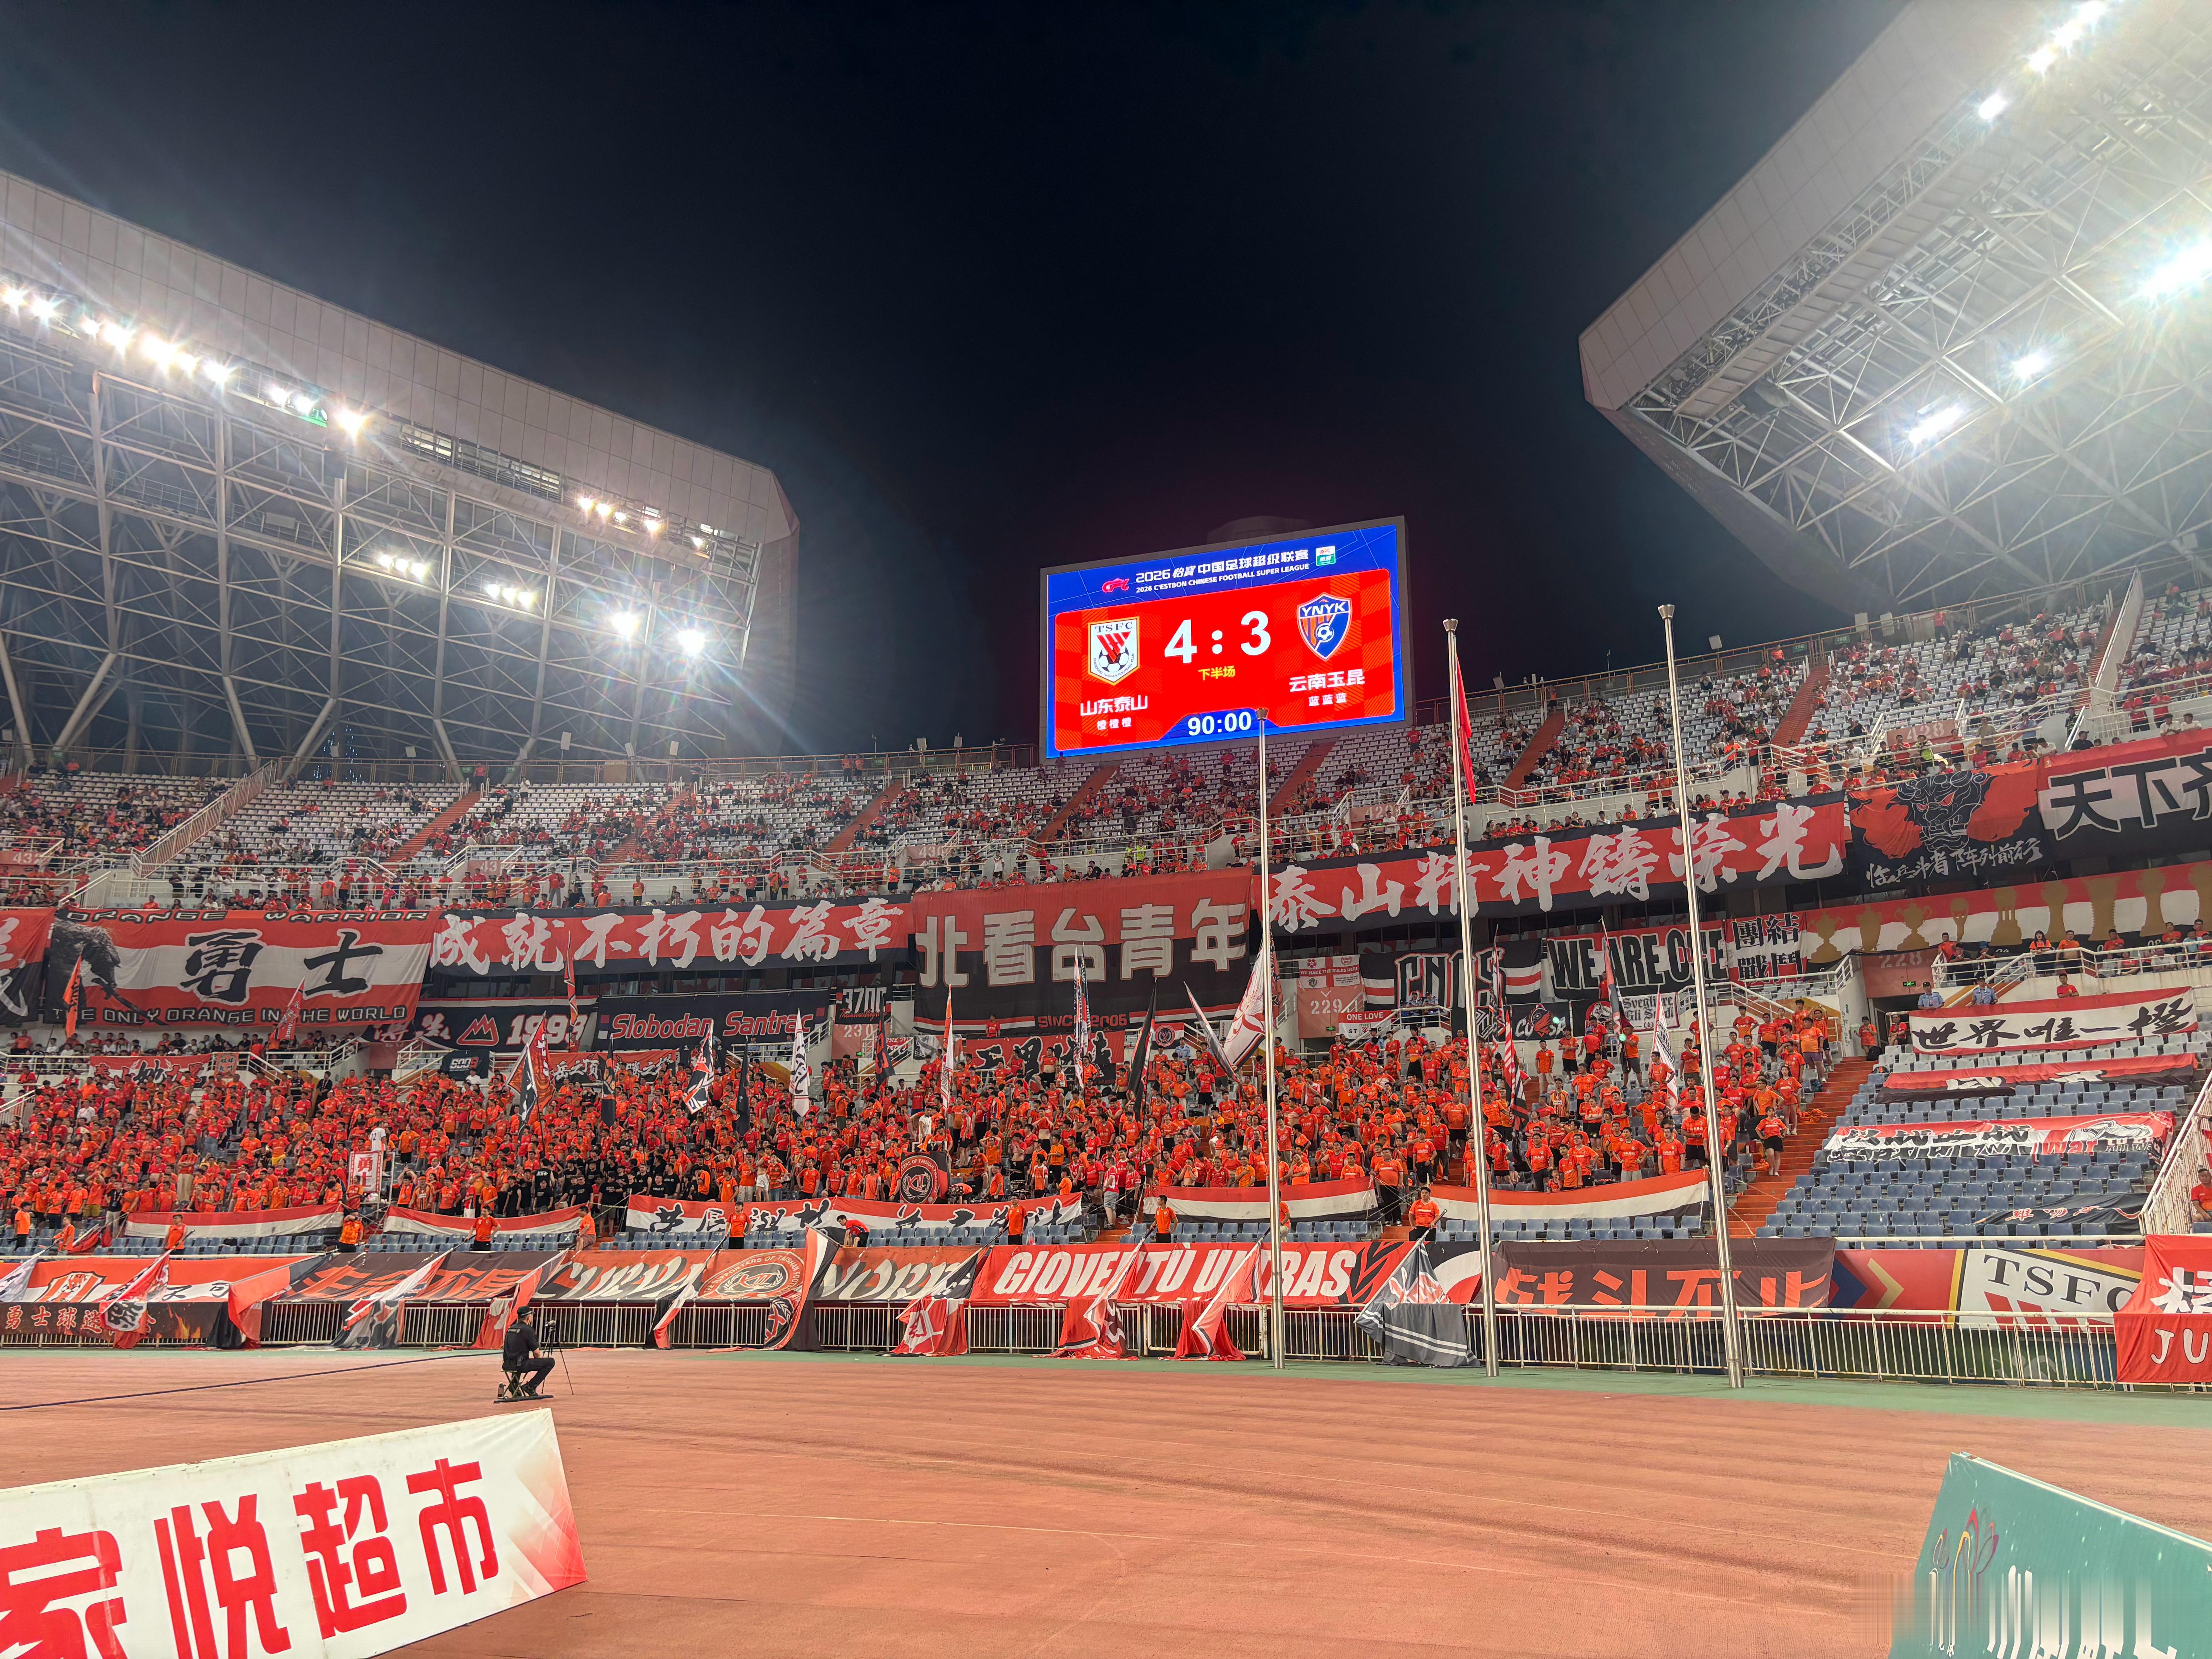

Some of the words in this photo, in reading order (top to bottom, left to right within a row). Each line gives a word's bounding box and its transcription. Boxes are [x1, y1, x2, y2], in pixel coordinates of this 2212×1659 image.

[1136, 569, 1171, 583] 2026
[1198, 549, 1309, 574] 中国足球超级联赛
[1136, 585, 1152, 593] 2026
[1153, 581, 1187, 591] C'ESTBON
[1188, 577, 1218, 586] CHINESE
[1218, 572, 1255, 582] FOOTBALL
[1256, 568, 1279, 577] SUPER
[1280, 563, 1309, 573] LEAGUE
[1302, 601, 1346, 617] YNYK
[1095, 622, 1133, 633] TSFC
[1164, 619, 1197, 664] 4
[1240, 610, 1271, 656] 3
[1198, 665, 1236, 680] 下半场
[1289, 668, 1366, 692] 云南玉昆
[1080, 694, 1148, 716] 山东泰山
[1187, 711, 1252, 736] 90:00
[1907, 723, 1945, 742] 428
[480, 860, 498, 872] 43
[67, 910, 228, 924] ORANGE
[264, 911, 428, 924] WARRIOR
[430, 897, 904, 975] 成就不朽的篇章
[915, 898, 1246, 988] 北看台青年
[180, 928, 384, 1003] 勇士
[1547, 938, 1600, 990] WE
[1602, 933, 1666, 988] ARE
[52, 1008, 96, 1021] TE
[104, 1008, 161, 1025] ONLY
[166, 1008, 254, 1024] ORANGE
[262, 1008, 279, 1022] IN
[337, 1005, 407, 1020] WORLD
[1310, 998, 1342, 1015] 229
[1364, 1012, 1384, 1020] LOVE
[1623, 996, 1674, 1010] Sveglire
[506, 1014, 589, 1045] 1993
[612, 1012, 713, 1039] Slobodan
[722, 1010, 813, 1036] Santrac
[1037, 1014, 1080, 1028] SINC
[1090, 1014, 1127, 1028] 2005
[1911, 998, 2194, 1050] 世界唯一橙
[357, 1156, 374, 1187] 勇士
[711, 1257, 762, 1284] SUPPORTERS
[777, 1254, 800, 1272] TAISHAN
[1494, 1267, 1827, 1322] 战斗不止
[5, 1305, 156, 1334] 勇士球迷
[0, 1458, 499, 1659] 家悦超市
